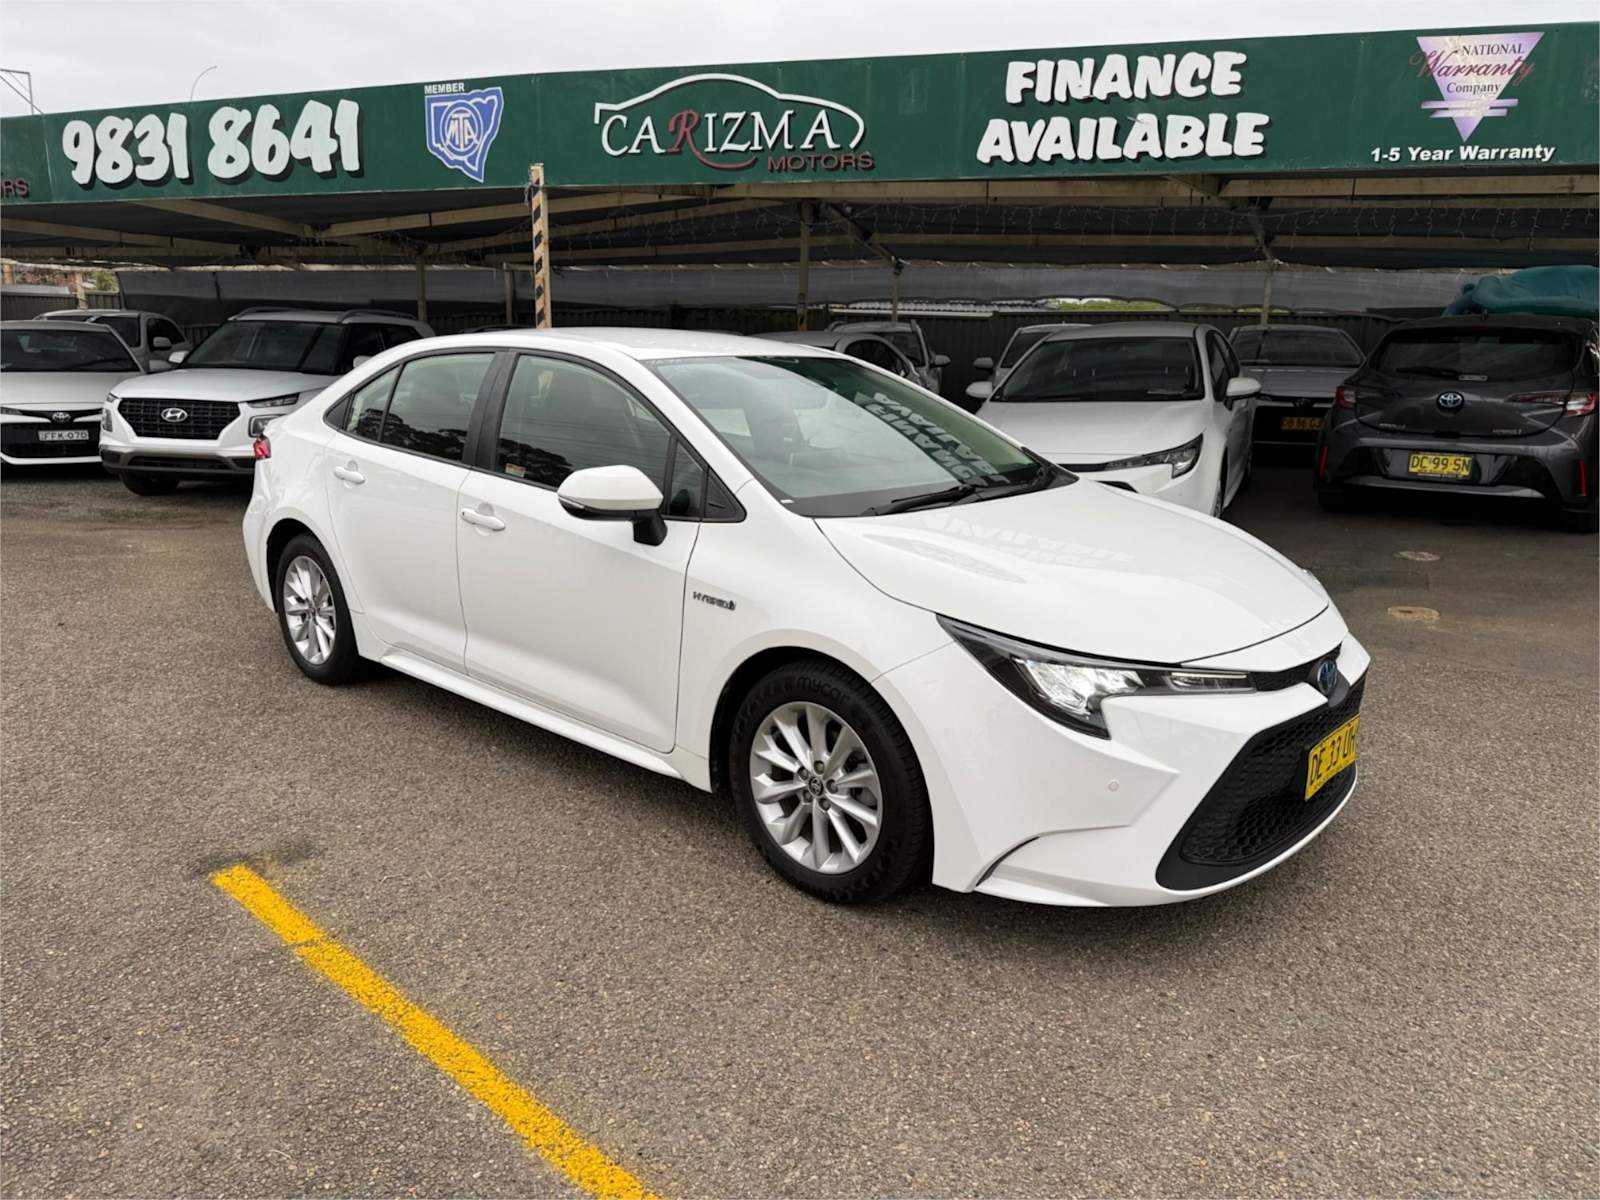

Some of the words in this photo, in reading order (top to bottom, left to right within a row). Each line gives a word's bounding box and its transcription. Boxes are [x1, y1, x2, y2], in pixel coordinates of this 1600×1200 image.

[1462, 43, 1525, 56] NATIONAL
[1005, 51, 1247, 103] FINANCE
[1409, 50, 1535, 85] Warranty
[424, 82, 465, 94] MEMBER
[1446, 82, 1501, 94] Company
[62, 112, 190, 185] 9831
[207, 99, 361, 180] 8641
[601, 109, 841, 168] CARIZMA
[976, 112, 1270, 164] AVAILABLE
[767, 152, 875, 171] MOTORS
[1370, 147, 1401, 162] 1-5
[1408, 146, 1455, 161] Year
[1459, 144, 1556, 162] Warranty
[1432, 456, 1449, 470] 99
